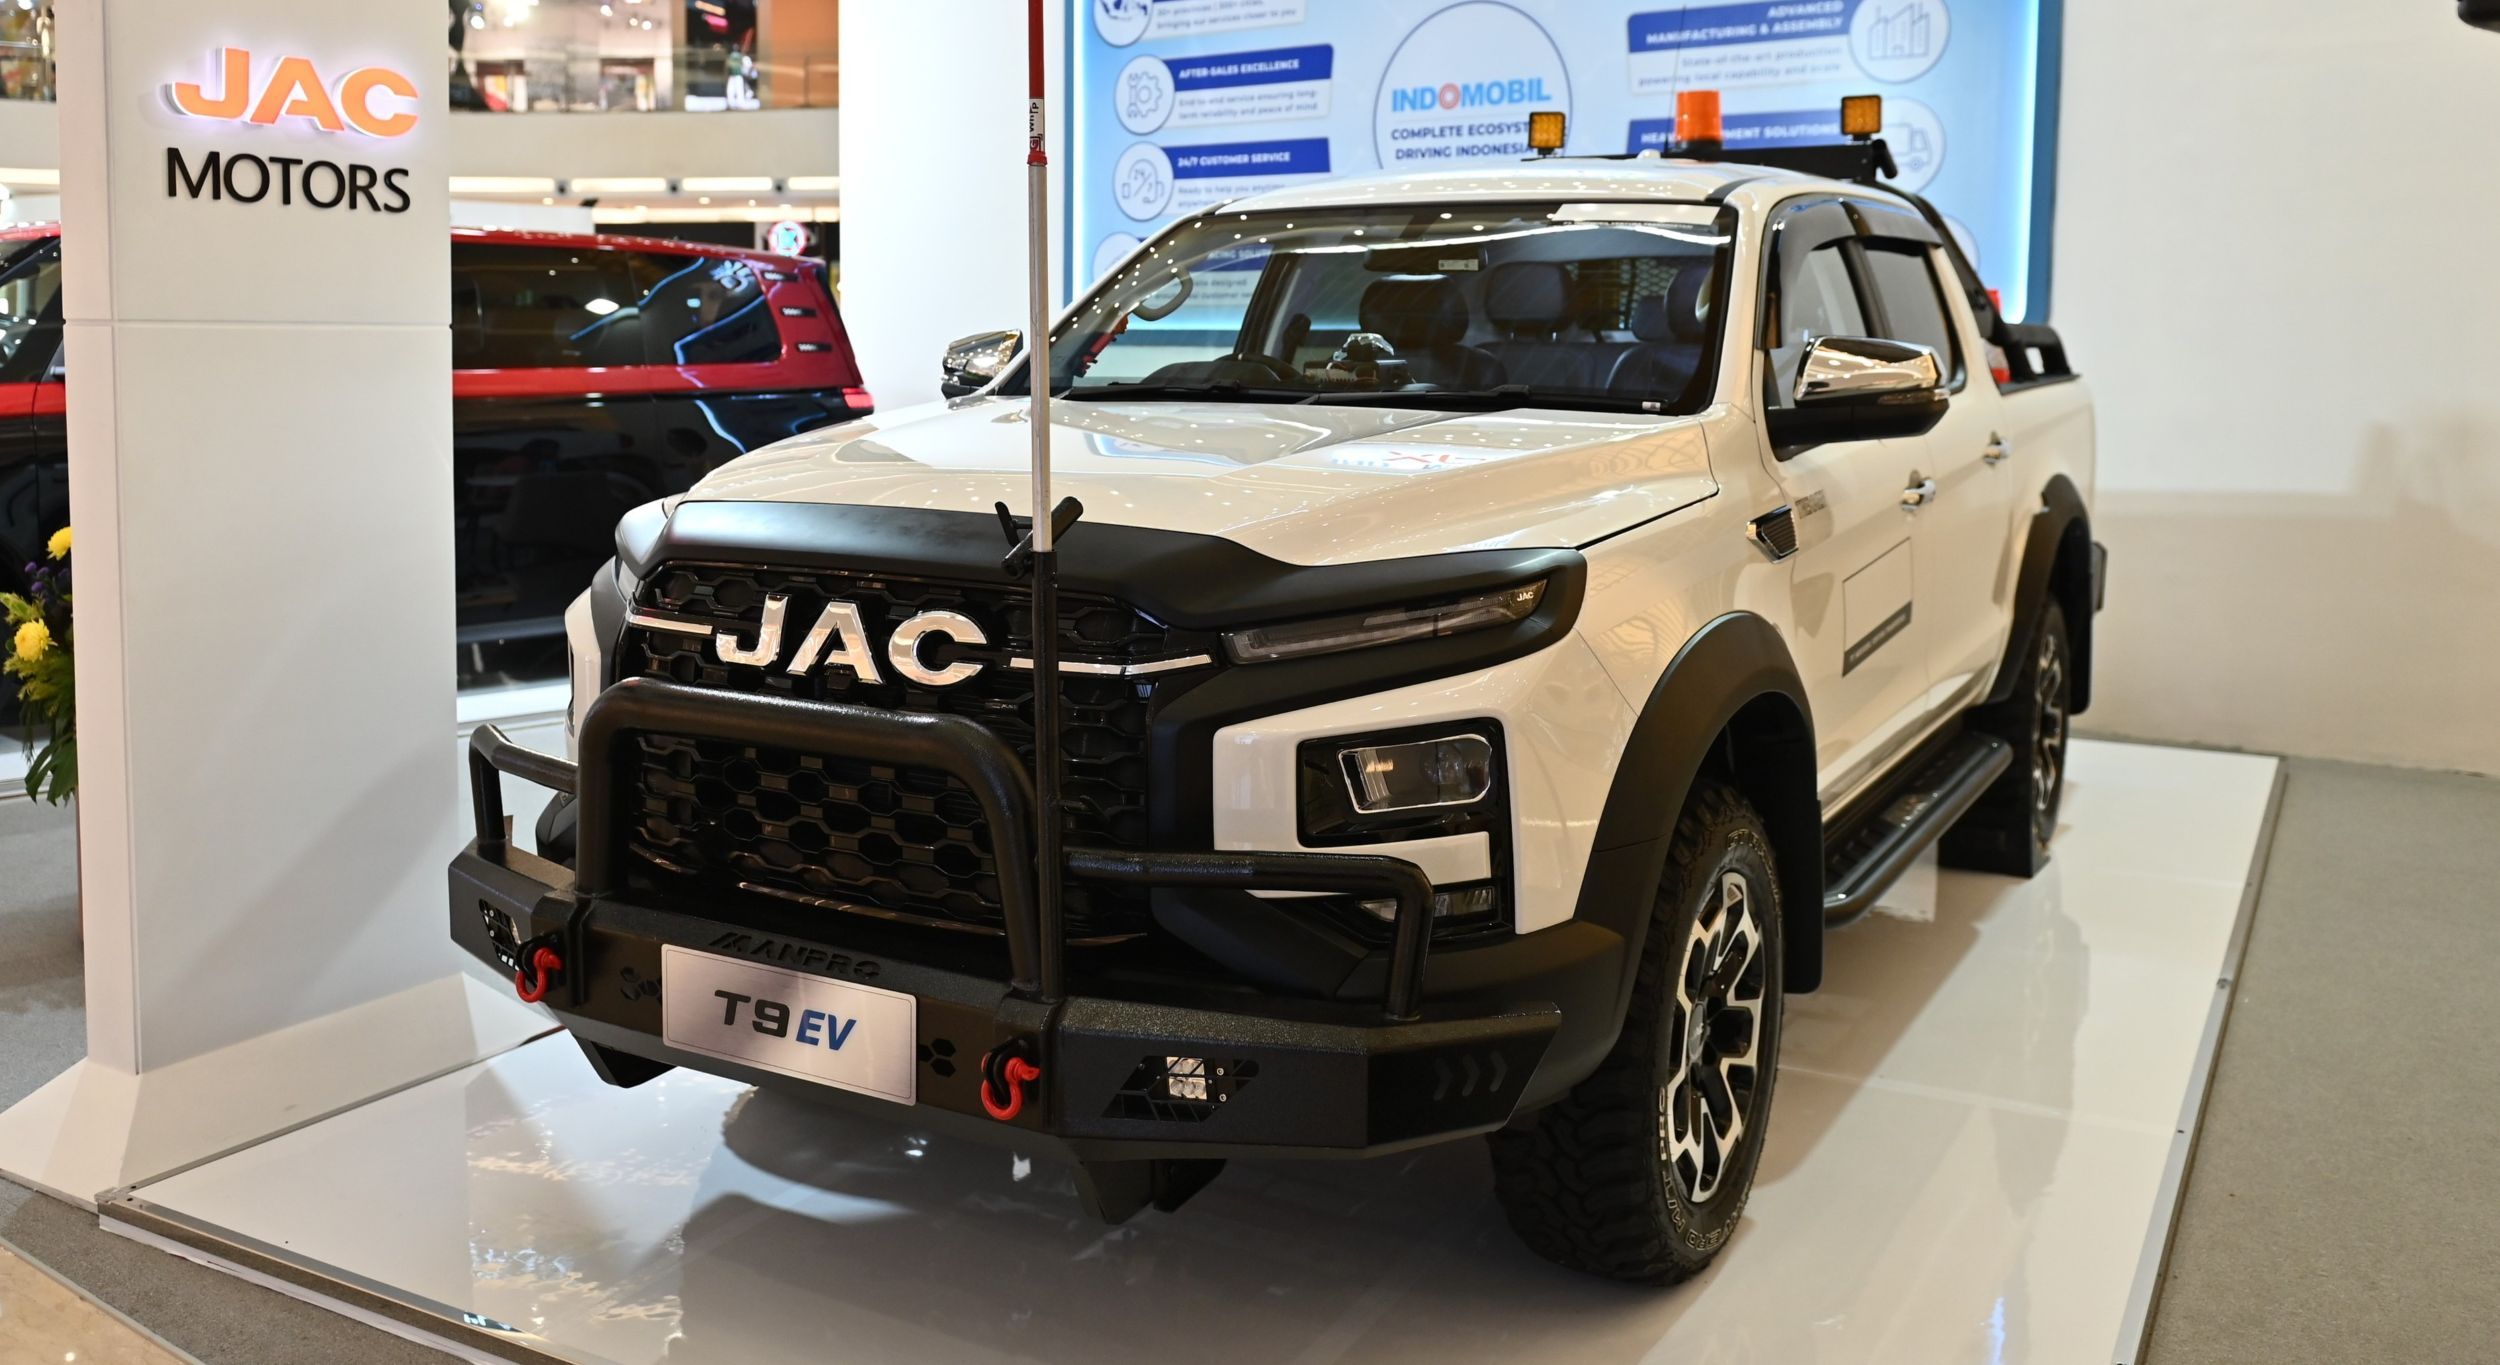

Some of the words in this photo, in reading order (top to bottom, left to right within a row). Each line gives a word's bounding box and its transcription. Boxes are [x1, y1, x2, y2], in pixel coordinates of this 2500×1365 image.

[1767, 1, 1845, 19] ADVANCED
[1646, 23, 1758, 45] MANUFACTURING
[1771, 16, 1845, 34] ASSEMBLY
[1178, 63, 1239, 79] AFTER-SALES
[1240, 58, 1300, 74] EXCELLENCE
[168, 46, 420, 139] JAC
[1391, 77, 1552, 113] INDOMOBIL
[1391, 124, 1464, 141] COMPLETE
[1468, 121, 1530, 137] ECOSYST
[1177, 156, 1199, 168] 24/7
[1199, 153, 1250, 167] CUSTOMER
[1250, 151, 1292, 164] SERVICE
[1395, 145, 1452, 160] DRIVING
[166, 147, 412, 214] MOTORS
[1516, 591, 1534, 602] JAC
[714, 592, 989, 687] JAC
